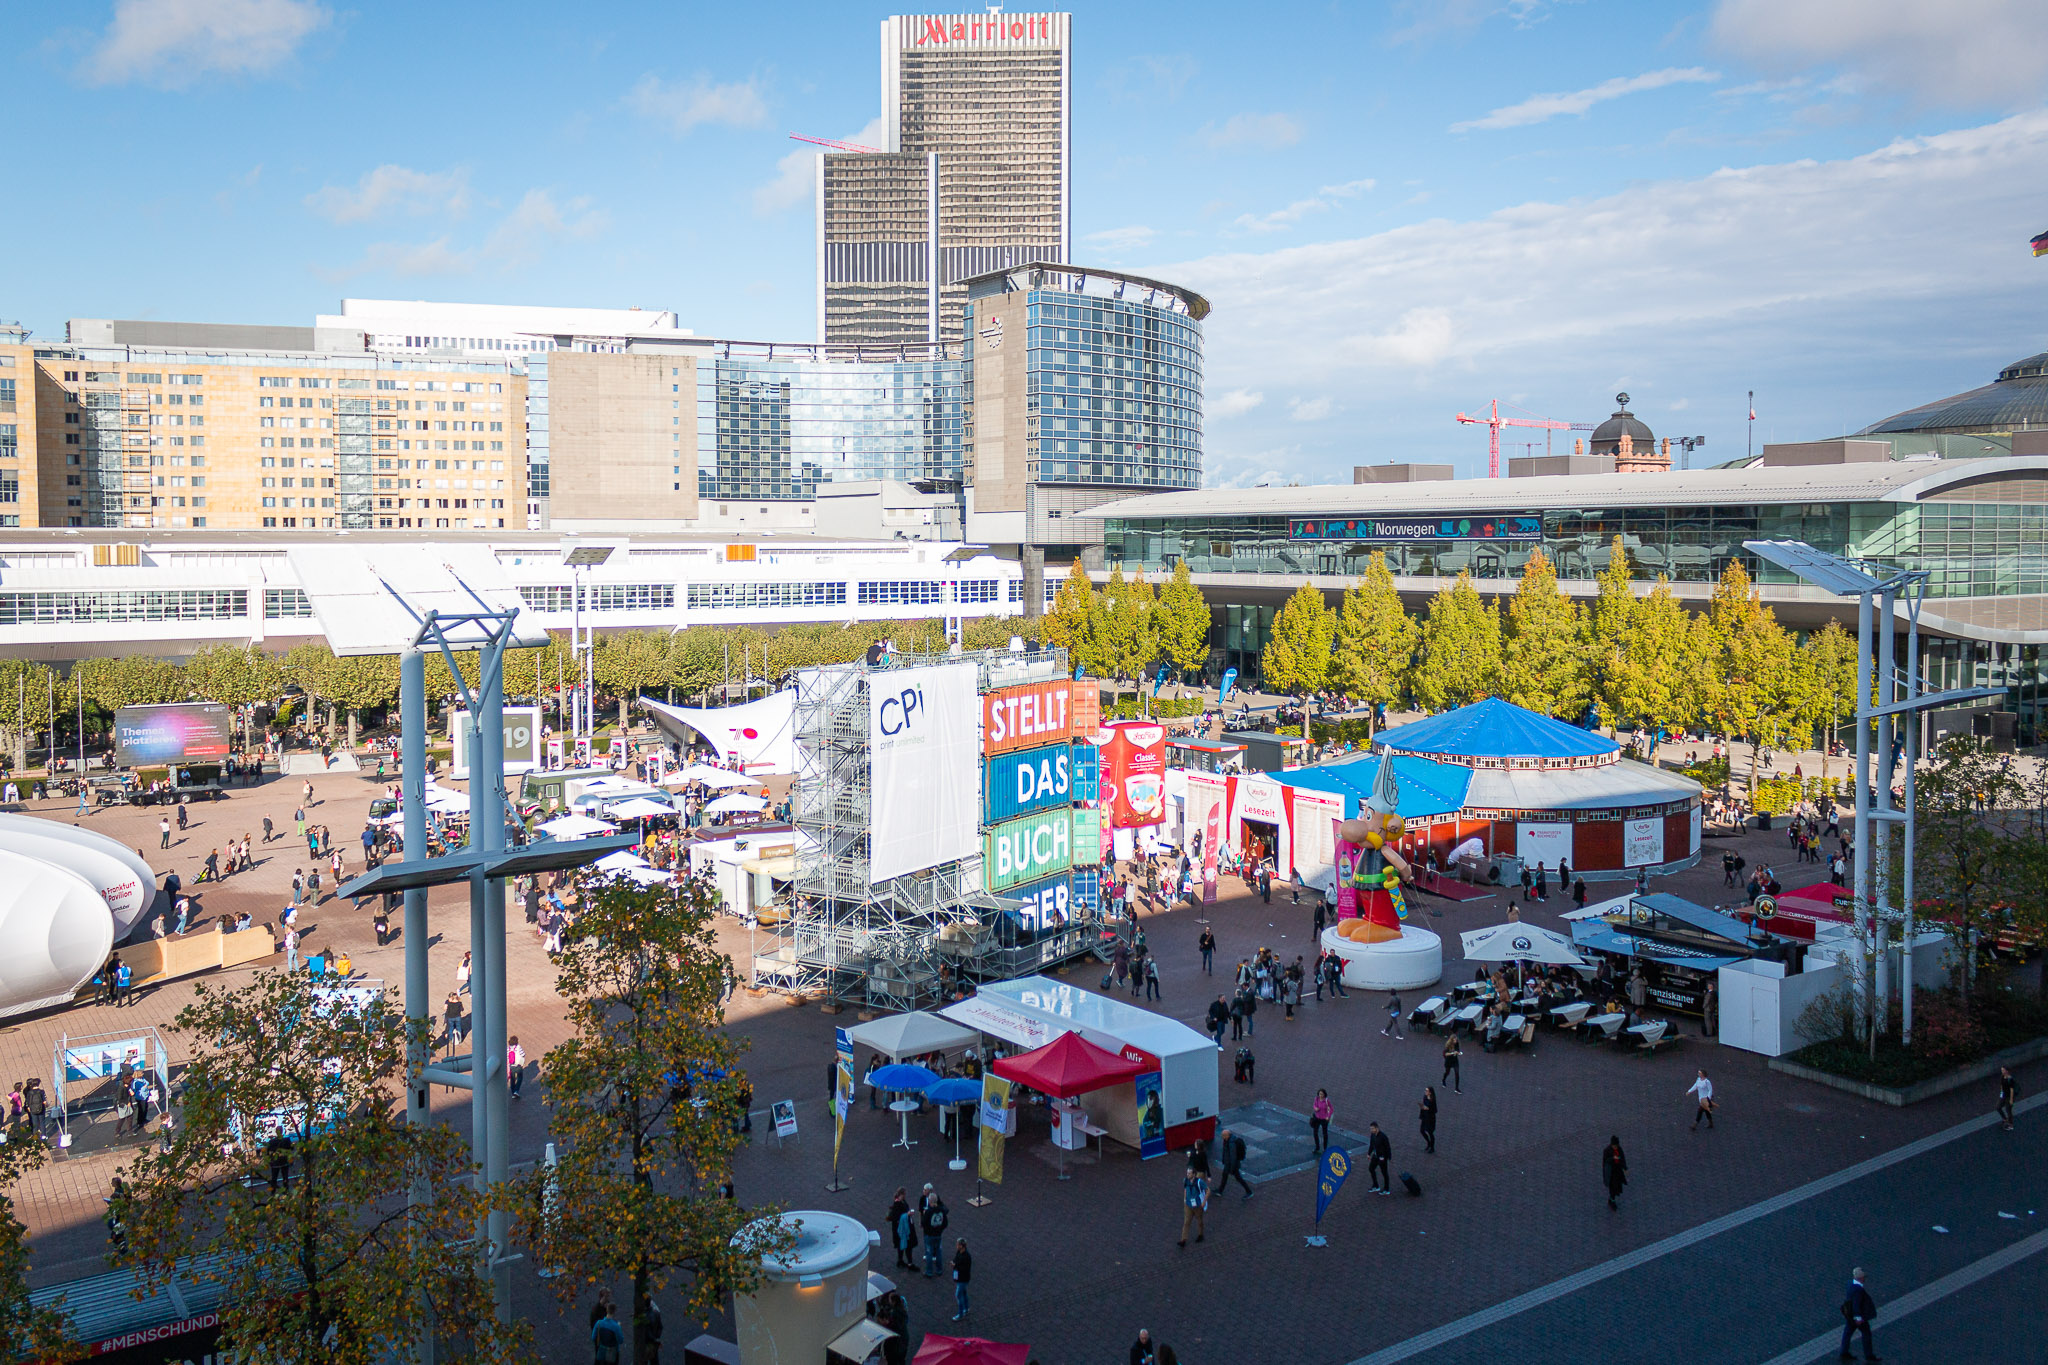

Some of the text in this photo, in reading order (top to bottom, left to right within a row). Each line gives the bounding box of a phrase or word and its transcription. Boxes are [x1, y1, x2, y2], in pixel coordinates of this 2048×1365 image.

[917, 16, 1048, 45] Marriott
[1376, 522, 1435, 538] Norwegen
[990, 690, 1068, 742] STELLT
[121, 727, 165, 737] Themen
[122, 736, 179, 747] platzieren.
[880, 740, 894, 750] print
[1134, 753, 1156, 762] Classic
[1018, 755, 1068, 803] DAS
[1244, 803, 1275, 818] Lesezelt
[998, 818, 1068, 877] BUCH
[106, 881, 136, 895] Frankfurt
[108, 890, 133, 902] Pavilion
[1636, 939, 1717, 959] Franziskaner
[1646, 986, 1695, 1005] Franziskaner
[1656, 997, 1683, 1009] WEISSBIER
[1126, 1051, 1143, 1063] Wir
